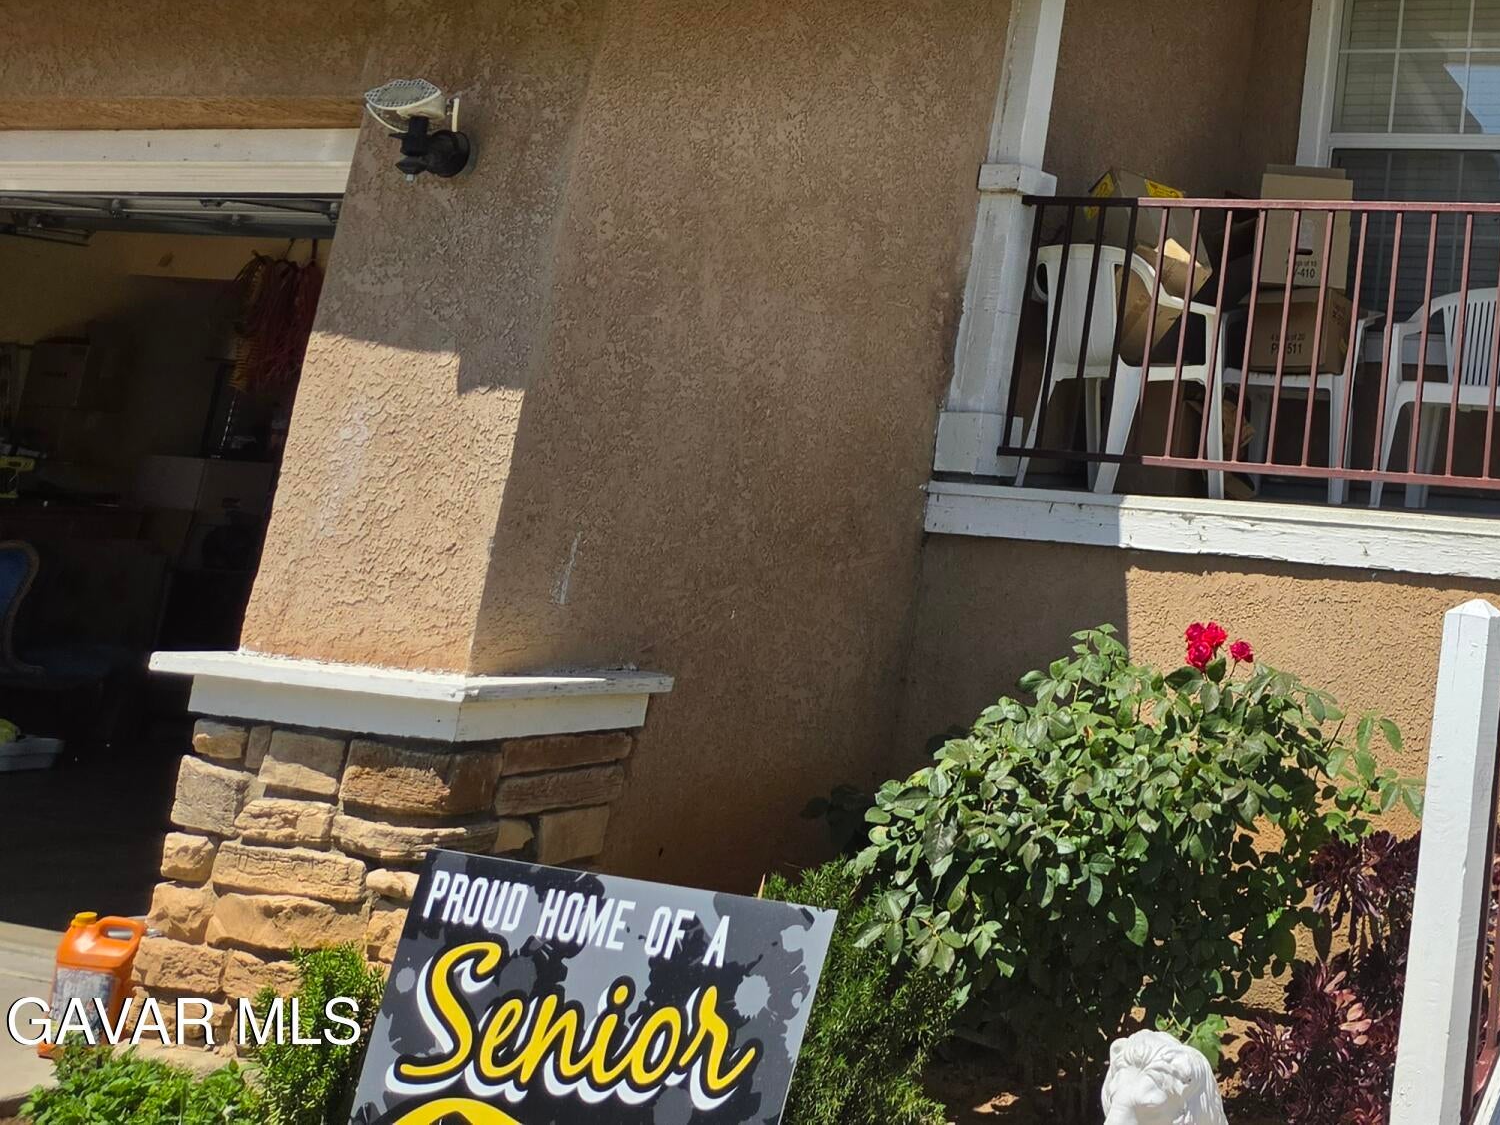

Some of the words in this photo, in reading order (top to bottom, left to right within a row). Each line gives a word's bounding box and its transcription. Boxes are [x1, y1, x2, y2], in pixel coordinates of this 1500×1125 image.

[422, 870, 530, 933] PROUD
[536, 888, 638, 950] HOME
[644, 905, 696, 961] OF
[702, 915, 732, 968] A
[393, 941, 757, 1095] Senior
